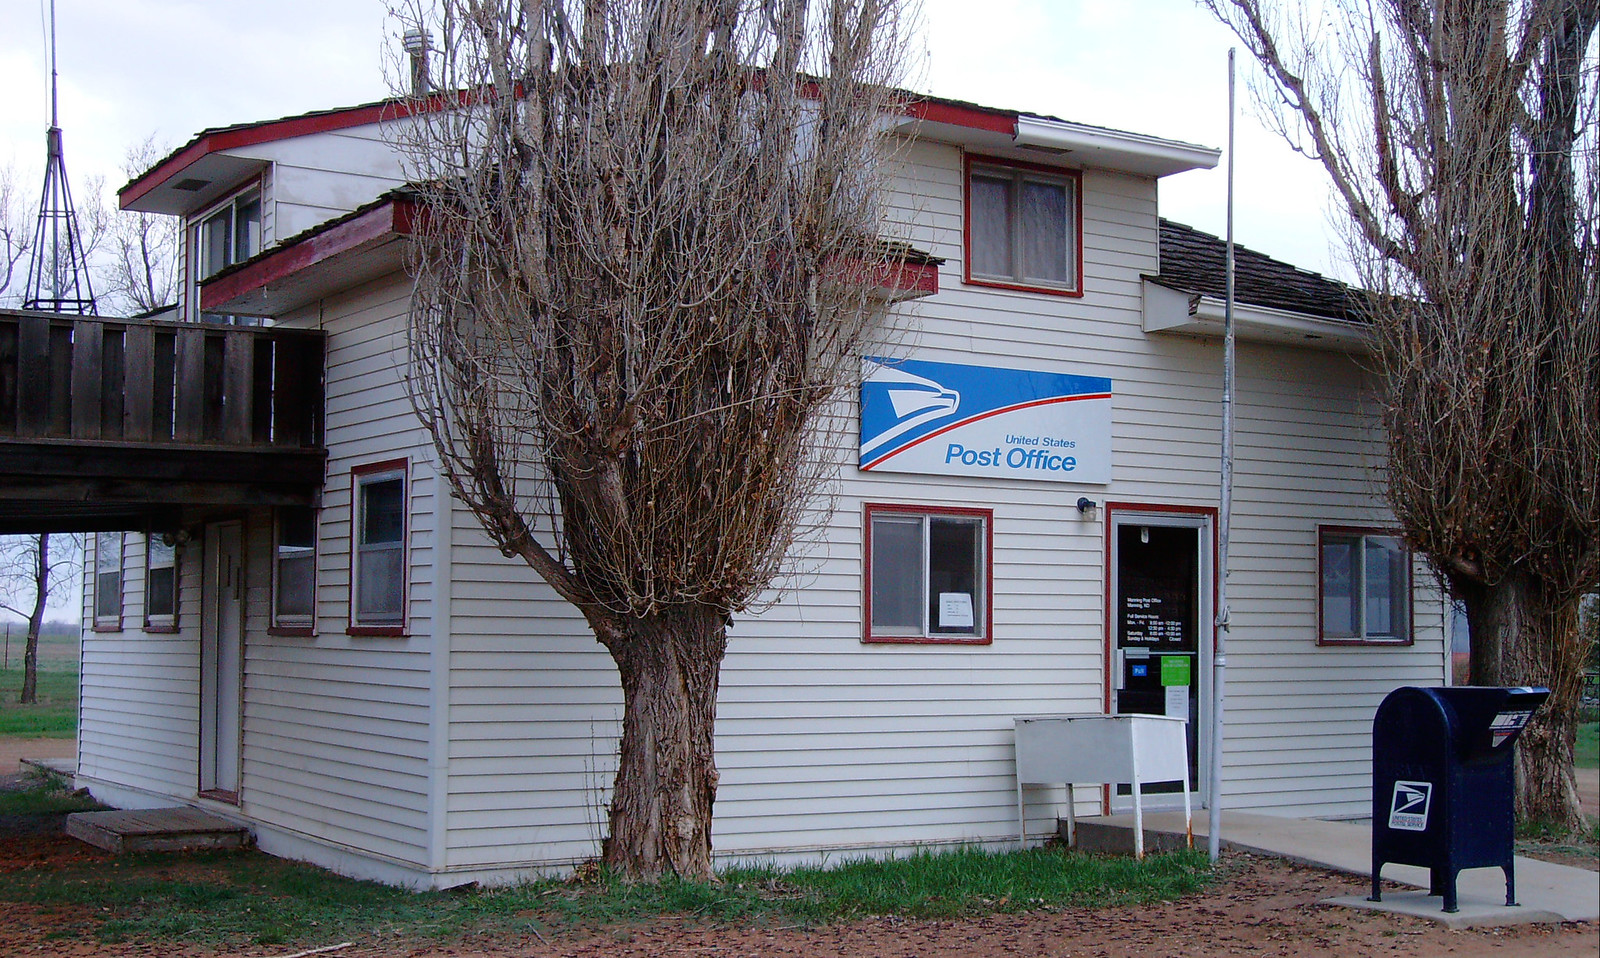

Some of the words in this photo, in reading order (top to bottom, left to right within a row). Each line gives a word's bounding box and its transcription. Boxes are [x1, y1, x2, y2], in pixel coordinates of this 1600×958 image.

[1005, 434, 1039, 446] United
[1042, 437, 1076, 449] States
[945, 443, 1001, 467] Post
[1006, 447, 1077, 472] Office
